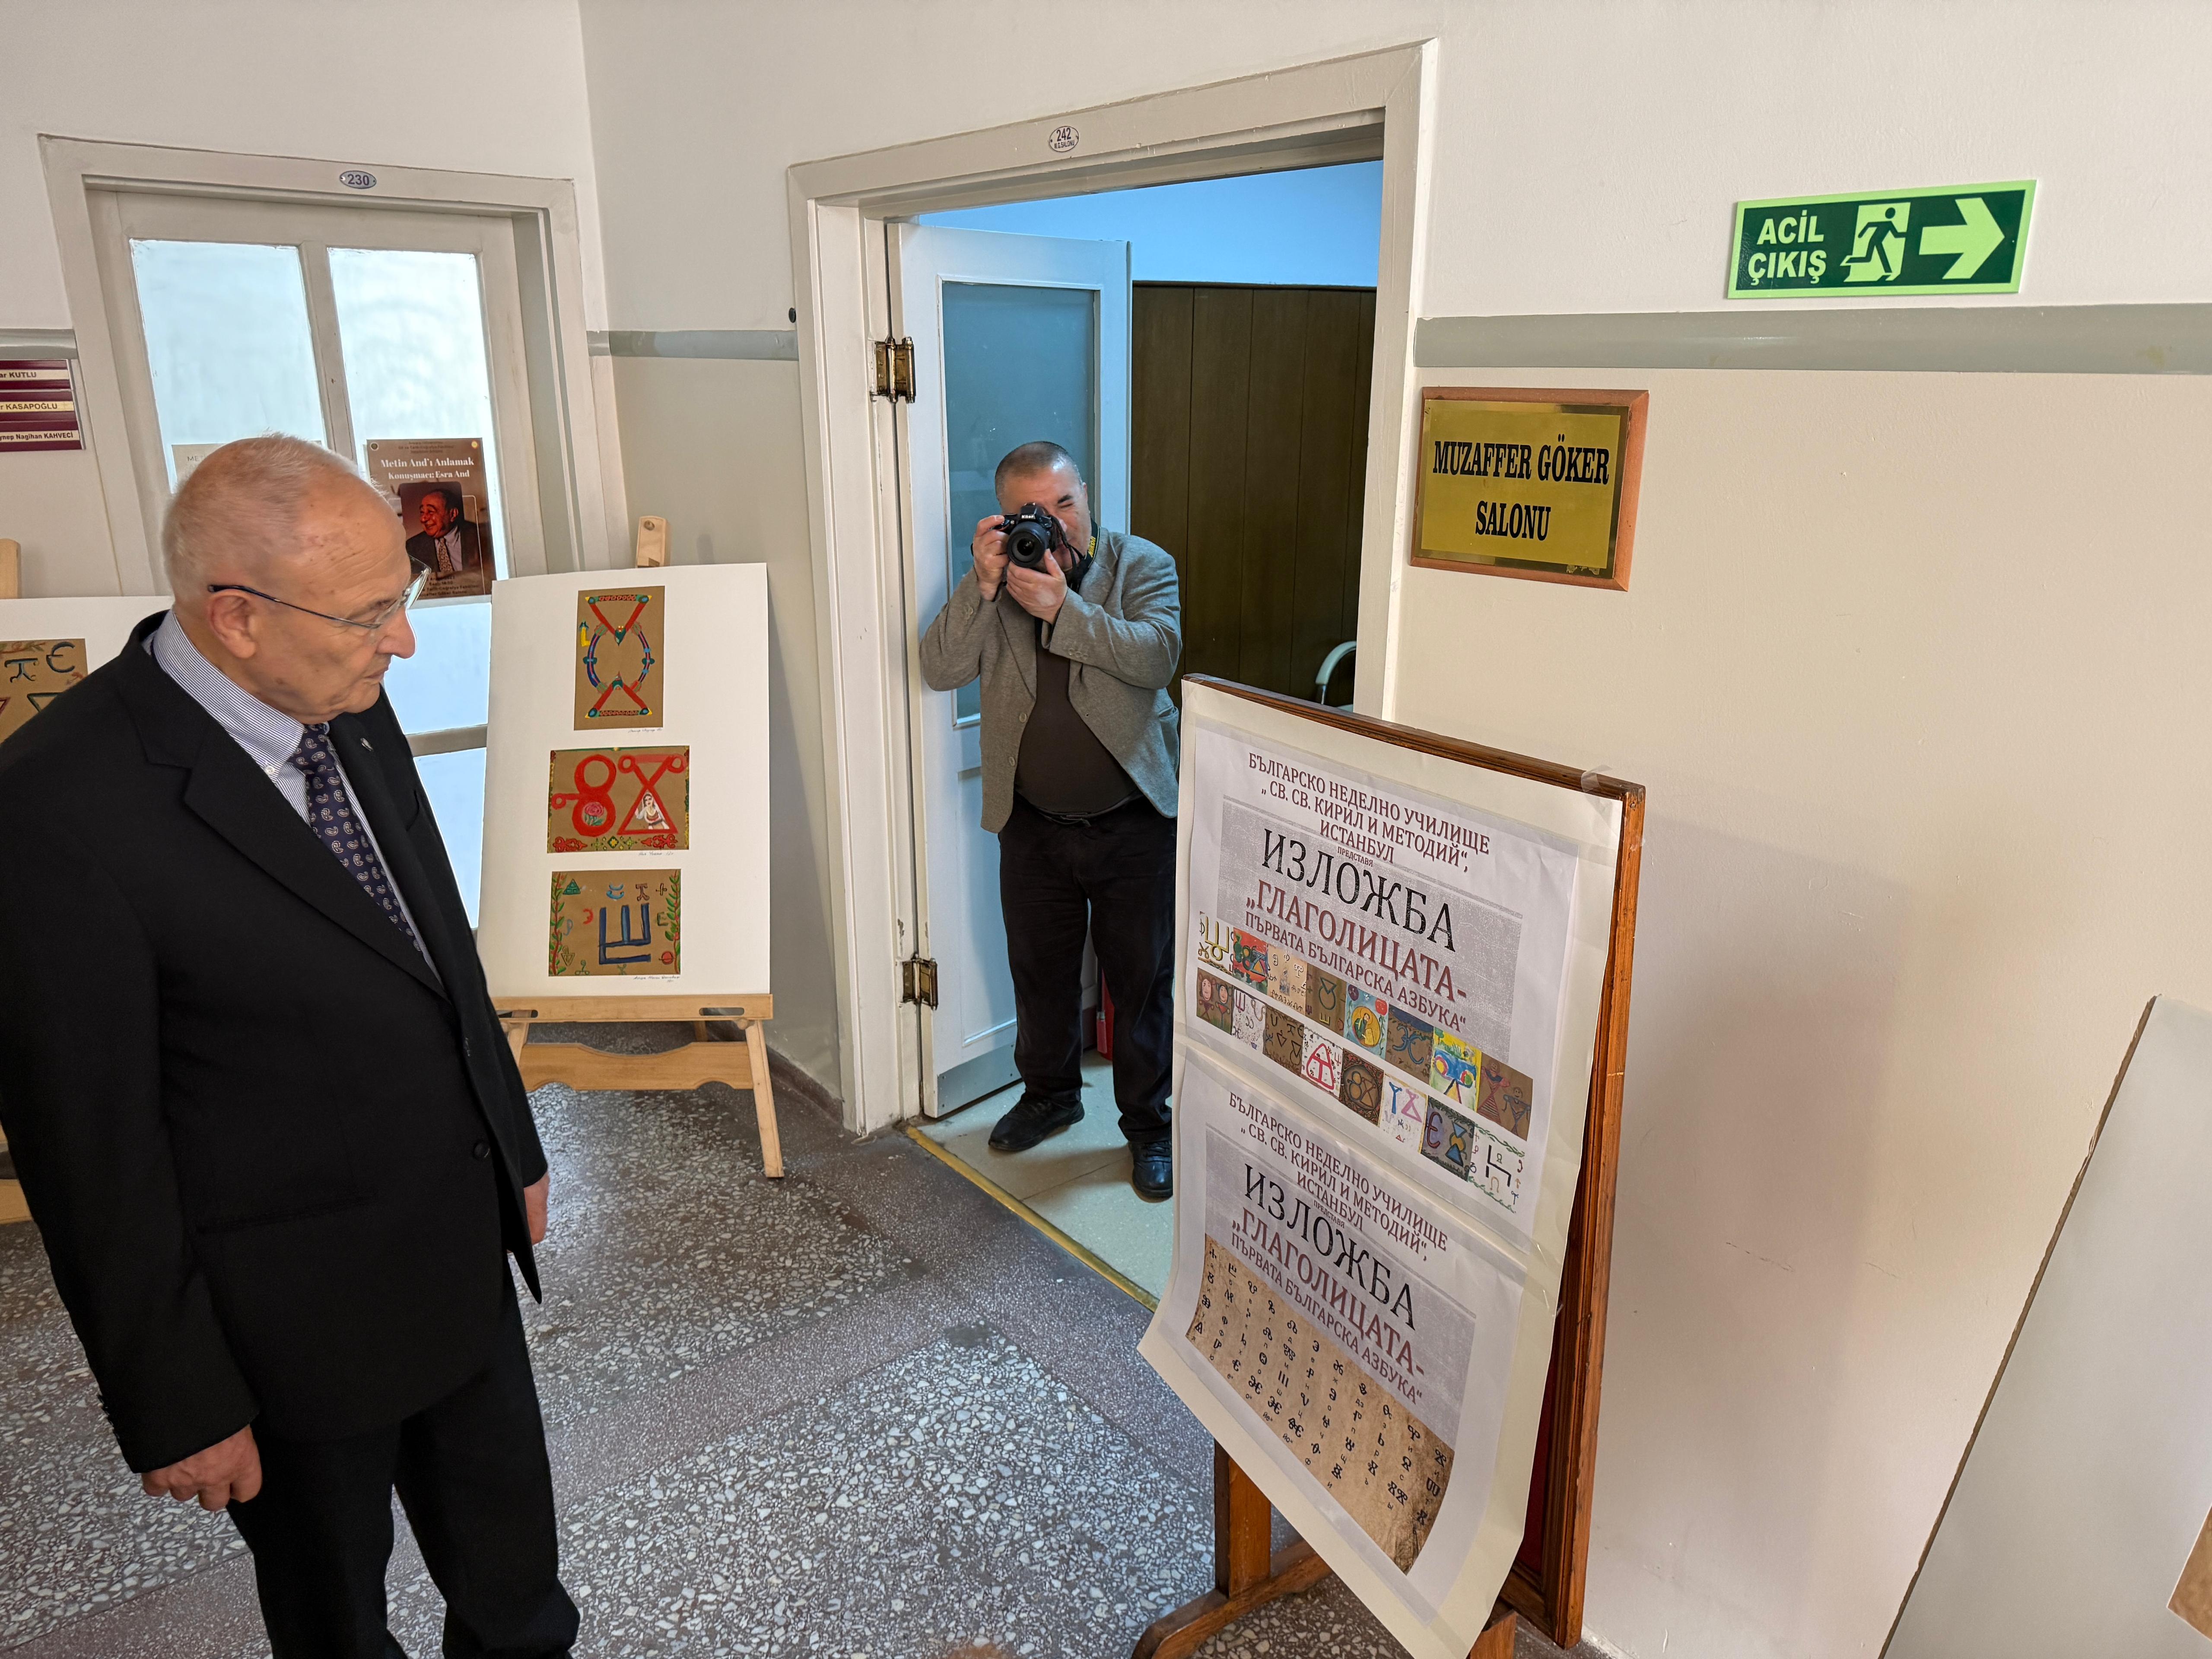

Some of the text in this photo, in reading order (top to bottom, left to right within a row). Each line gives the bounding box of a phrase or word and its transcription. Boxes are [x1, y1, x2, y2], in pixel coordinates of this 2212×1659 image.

[1056, 127, 1071, 142] 242
[347, 174, 369, 185] 230
[1757, 210, 1825, 245] ACİL
[1748, 250, 1827, 286] ÇIKIŞ
[381, 459, 407, 467] Metin
[435, 457, 474, 466] Anlamak
[1433, 433, 1610, 485] MUZAFFER GÖKER
[1475, 500, 1551, 541] SALONU
[1249, 752, 1490, 855] БЪЛГАРСКО НЕДЕЛНО УЧИЛИЩЕ
[1270, 781, 1288, 801] СВ.
[1292, 789, 1311, 810] СВ.
[1315, 796, 1363, 830] КИРИЛ
[1368, 816, 1378, 835] И
[1320, 819, 1395, 864] ИСТАНБУЛ
[1338, 846, 1373, 867] ПРЕДСТАВЯ
[1262, 828, 1456, 952] ИЗЛОЖБА
[1245, 911, 1304, 953] ПЪРВАТА
[1308, 943, 1394, 998] БЪЛГАРСКА
[1230, 1092, 1448, 1252] БЪЛГАРСКО НЕДЕЛНО УЧИЛИЩЕ
[1249, 1124, 1267, 1145] СВ.
[1271, 1137, 1287, 1160] СВ.
[1291, 1149, 1336, 1192] КИРИЛ
[1340, 1182, 1350, 1201] И
[1297, 1171, 1363, 1232] ИСТАНБУЛ
[1314, 1200, 1345, 1229] ПРЕДСТАВЯ
[1245, 1163, 1416, 1331] ИЗЛОЖБА
[1232, 1232, 1283, 1288] ПЪРВАТА
[1286, 1278, 1359, 1355] БЪЛГАРСКА
